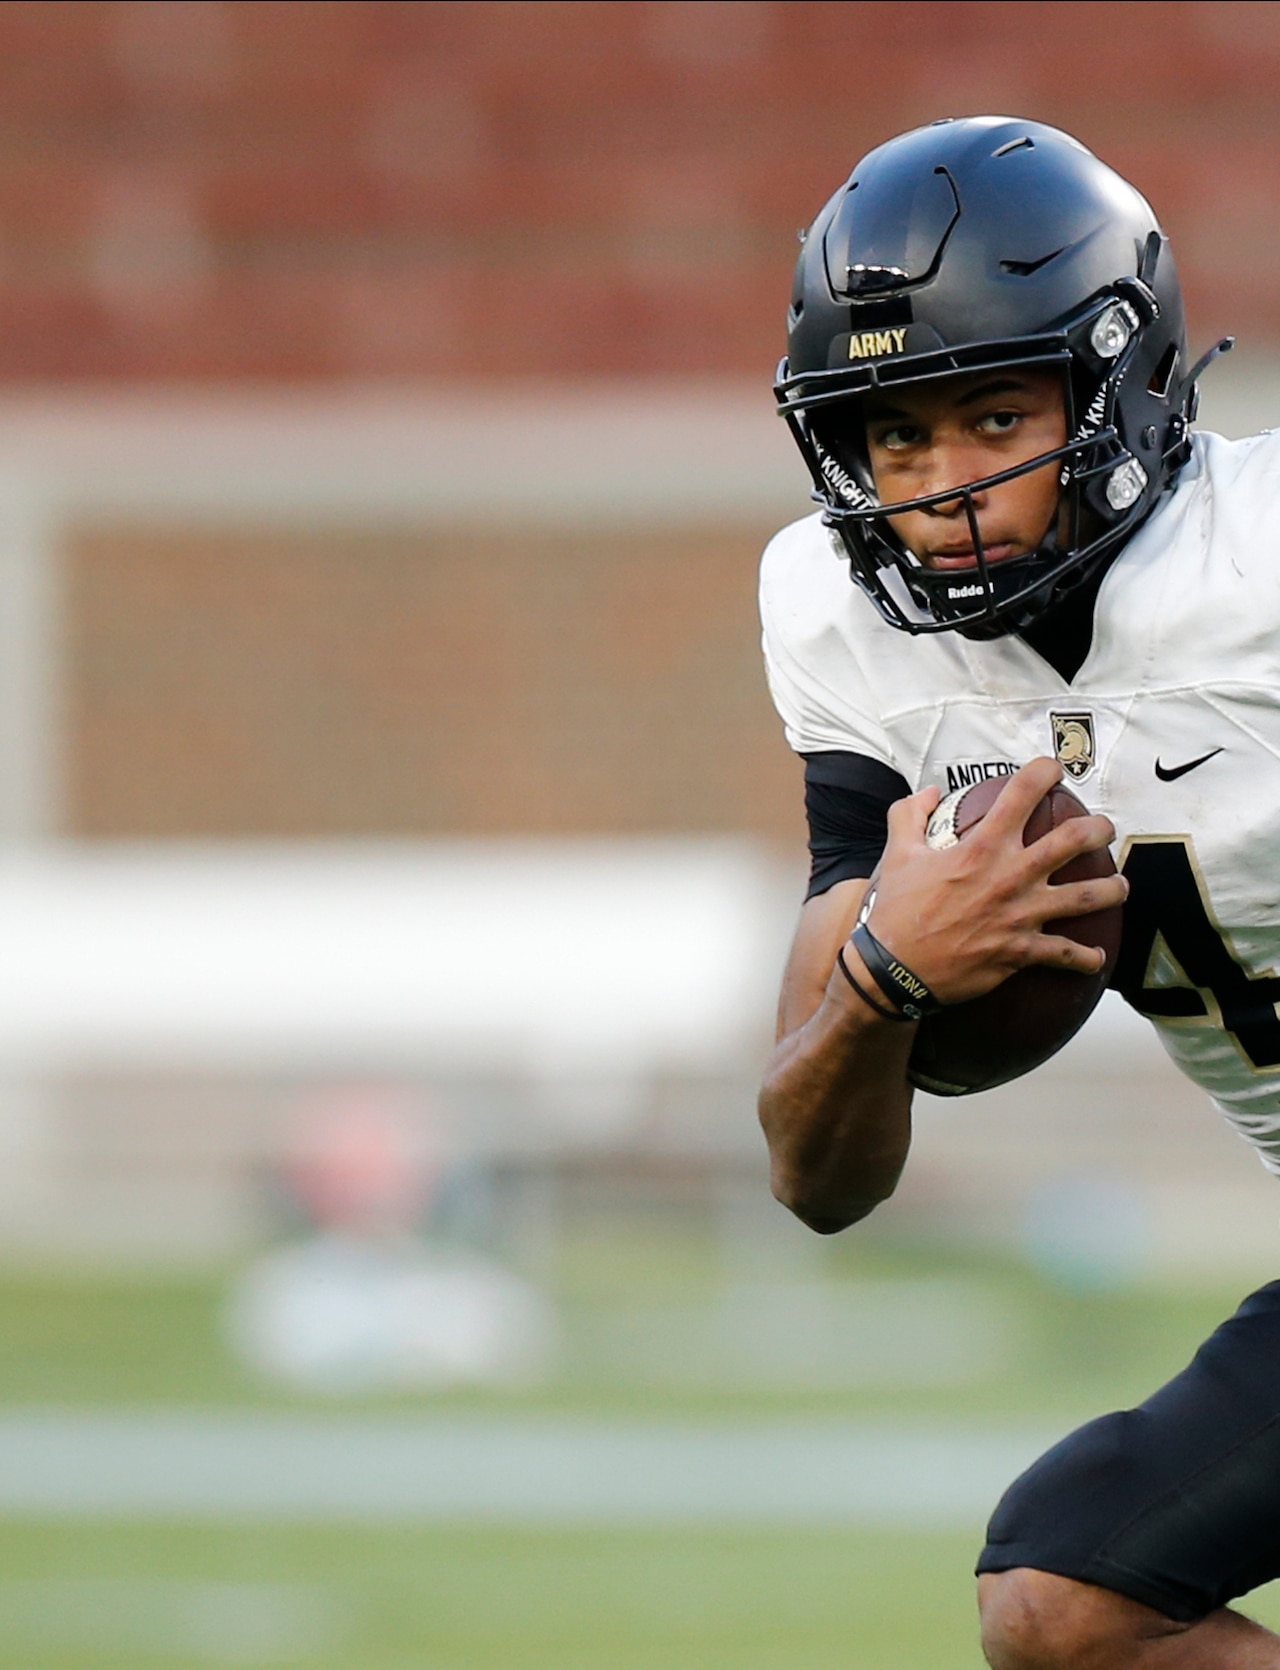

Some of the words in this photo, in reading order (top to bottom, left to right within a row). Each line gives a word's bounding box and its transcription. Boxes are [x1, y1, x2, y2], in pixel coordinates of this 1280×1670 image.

[848, 327, 908, 360] ARMY
[821, 455, 876, 522] KNIGHT
[947, 582, 994, 600] Riddel
